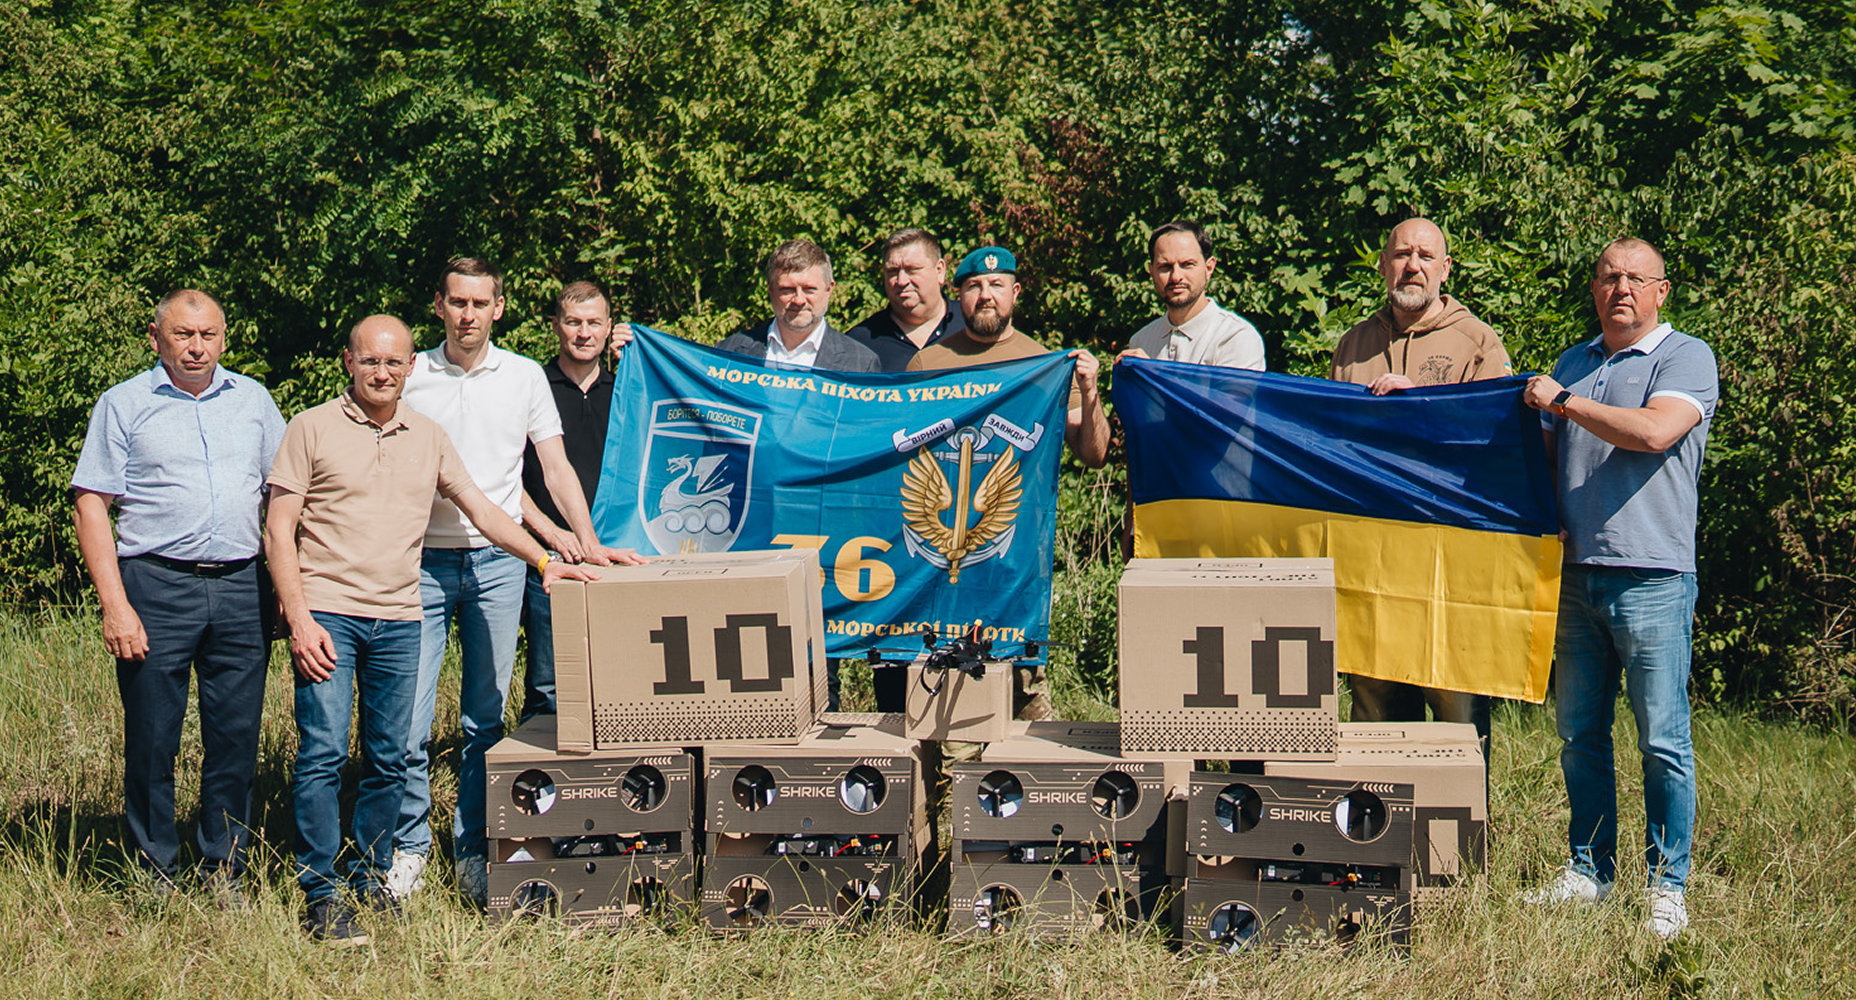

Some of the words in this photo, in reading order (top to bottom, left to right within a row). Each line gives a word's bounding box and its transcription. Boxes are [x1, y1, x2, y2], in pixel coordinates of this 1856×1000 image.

[707, 366, 816, 391] МОРСЬКА
[821, 382, 903, 403] ПІХОТА
[907, 382, 1002, 403] УКРАЇНИ
[706, 410, 746, 430] ПОБОРЕТЕ
[988, 418, 1025, 442] ЗАВЖДИ
[911, 422, 947, 445] ВІРНИЙ
[946, 620, 1026, 643] ПІОТИ
[649, 612, 794, 696] 10
[1182, 626, 1335, 709] 10
[561, 786, 618, 801] SHRIKE
[779, 785, 836, 799] SHRIKE
[1028, 792, 1087, 804] SHRIKE
[1269, 807, 1332, 824] SHRIKE
